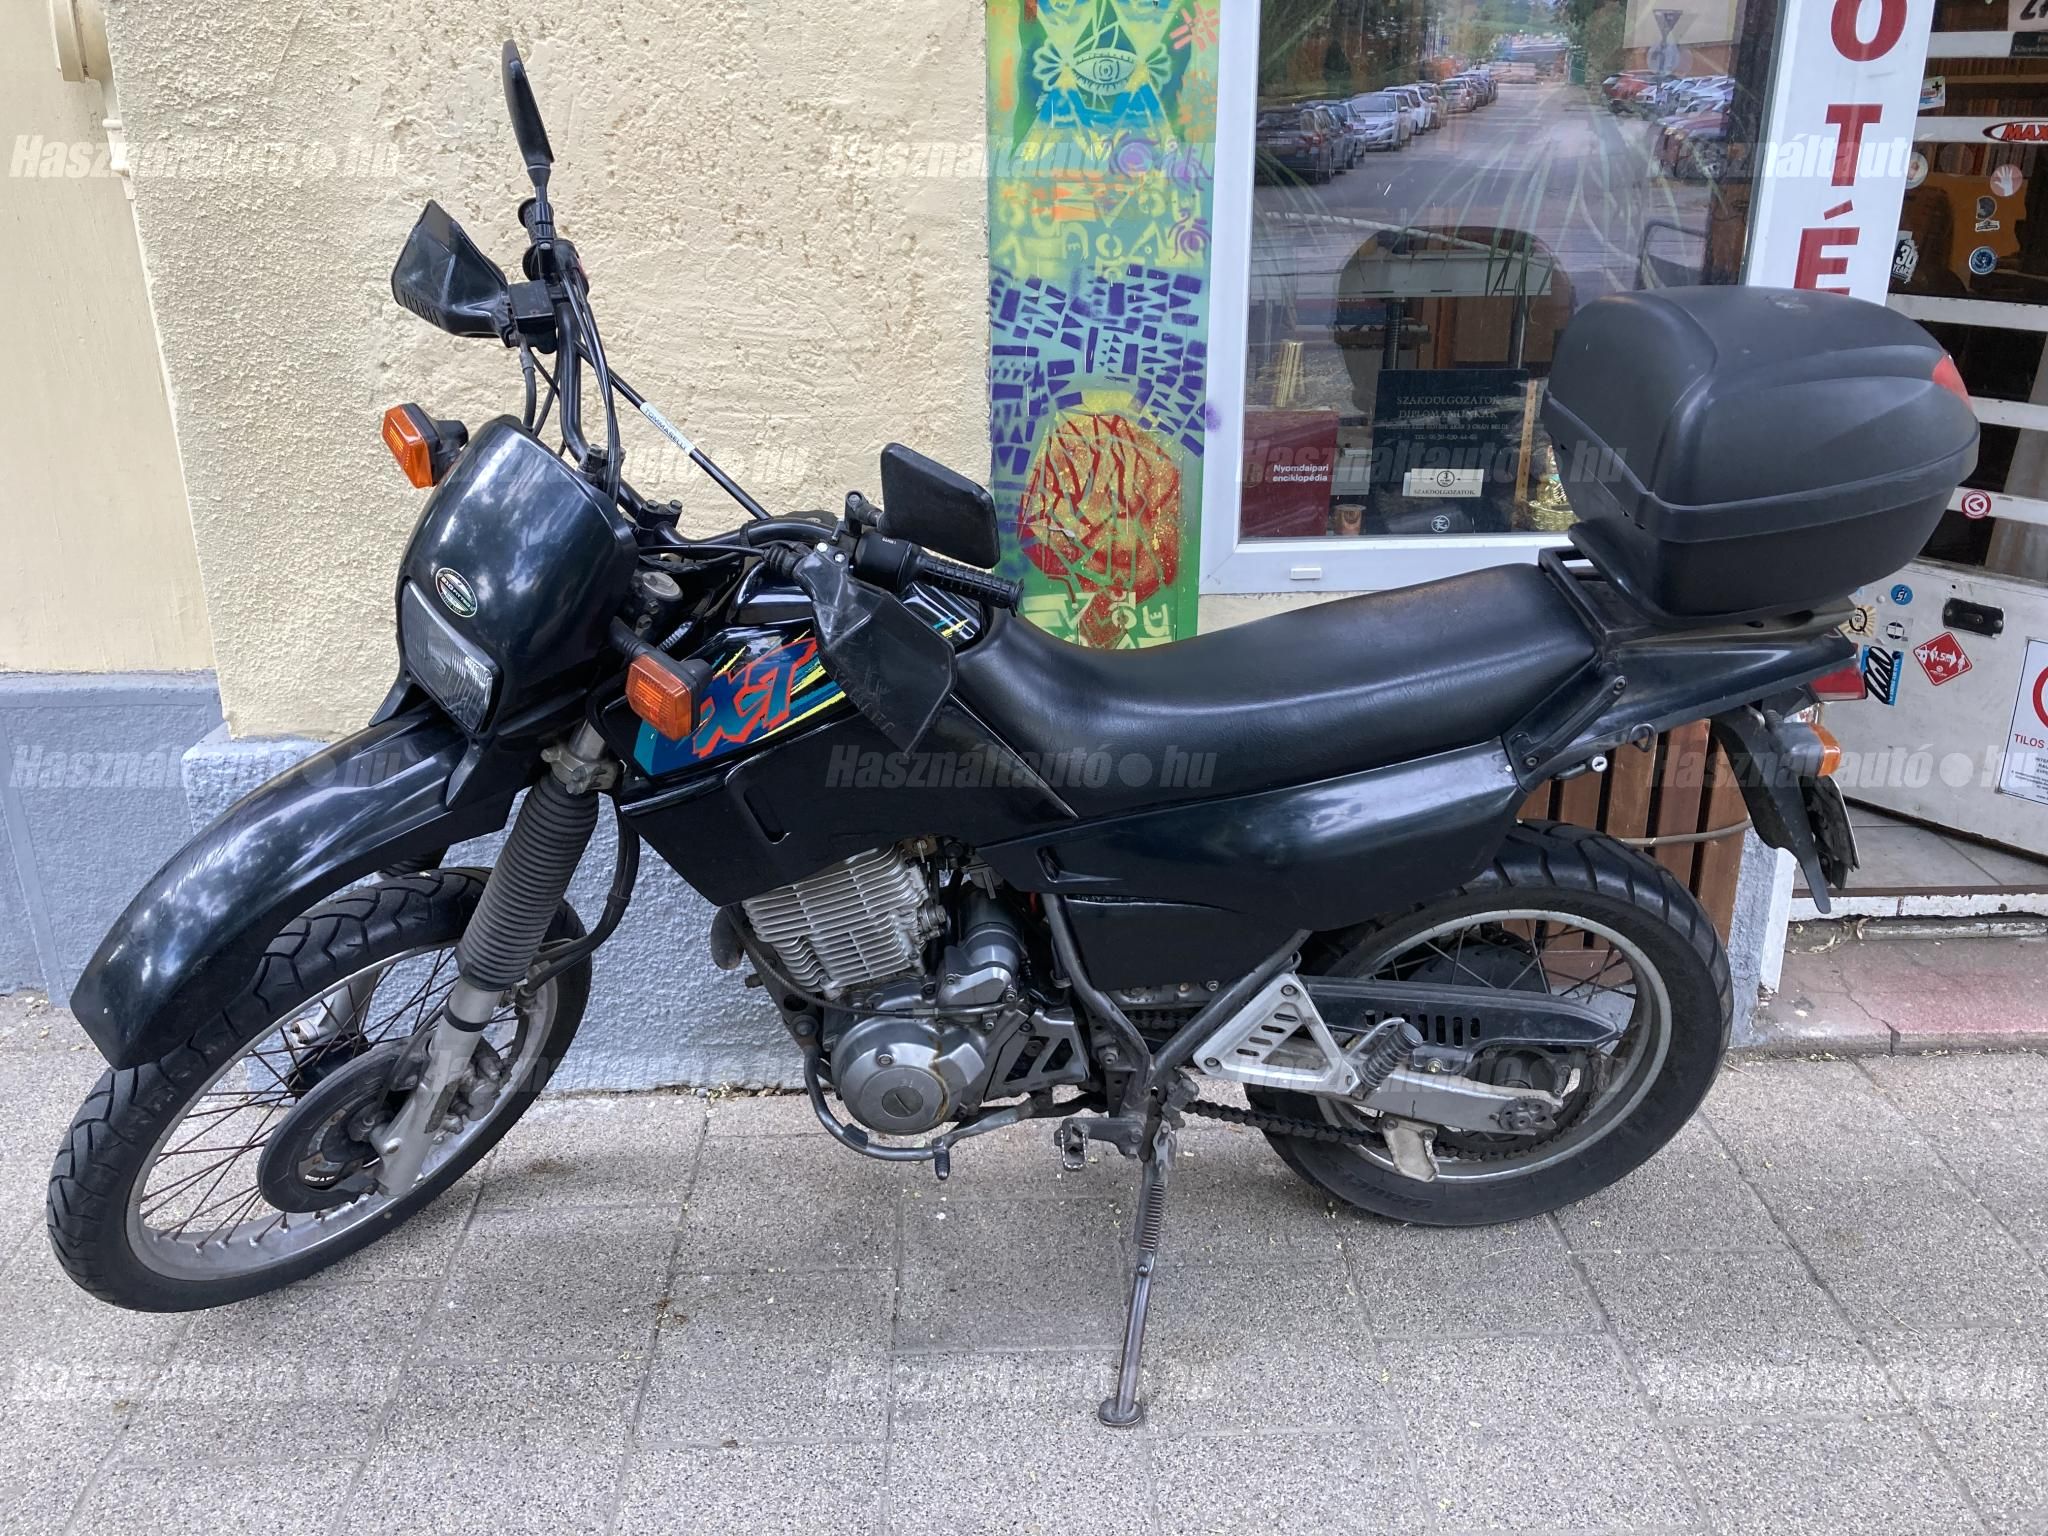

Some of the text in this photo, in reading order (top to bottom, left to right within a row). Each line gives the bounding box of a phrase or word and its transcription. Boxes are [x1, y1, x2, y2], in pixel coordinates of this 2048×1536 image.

[644, 408, 688, 450] TOMMASELLI
[1273, 463, 1329, 474] Nyomdaipari
[1272, 474, 1328, 482] enciklopédia
[2014, 733, 2046, 749] TILOS
